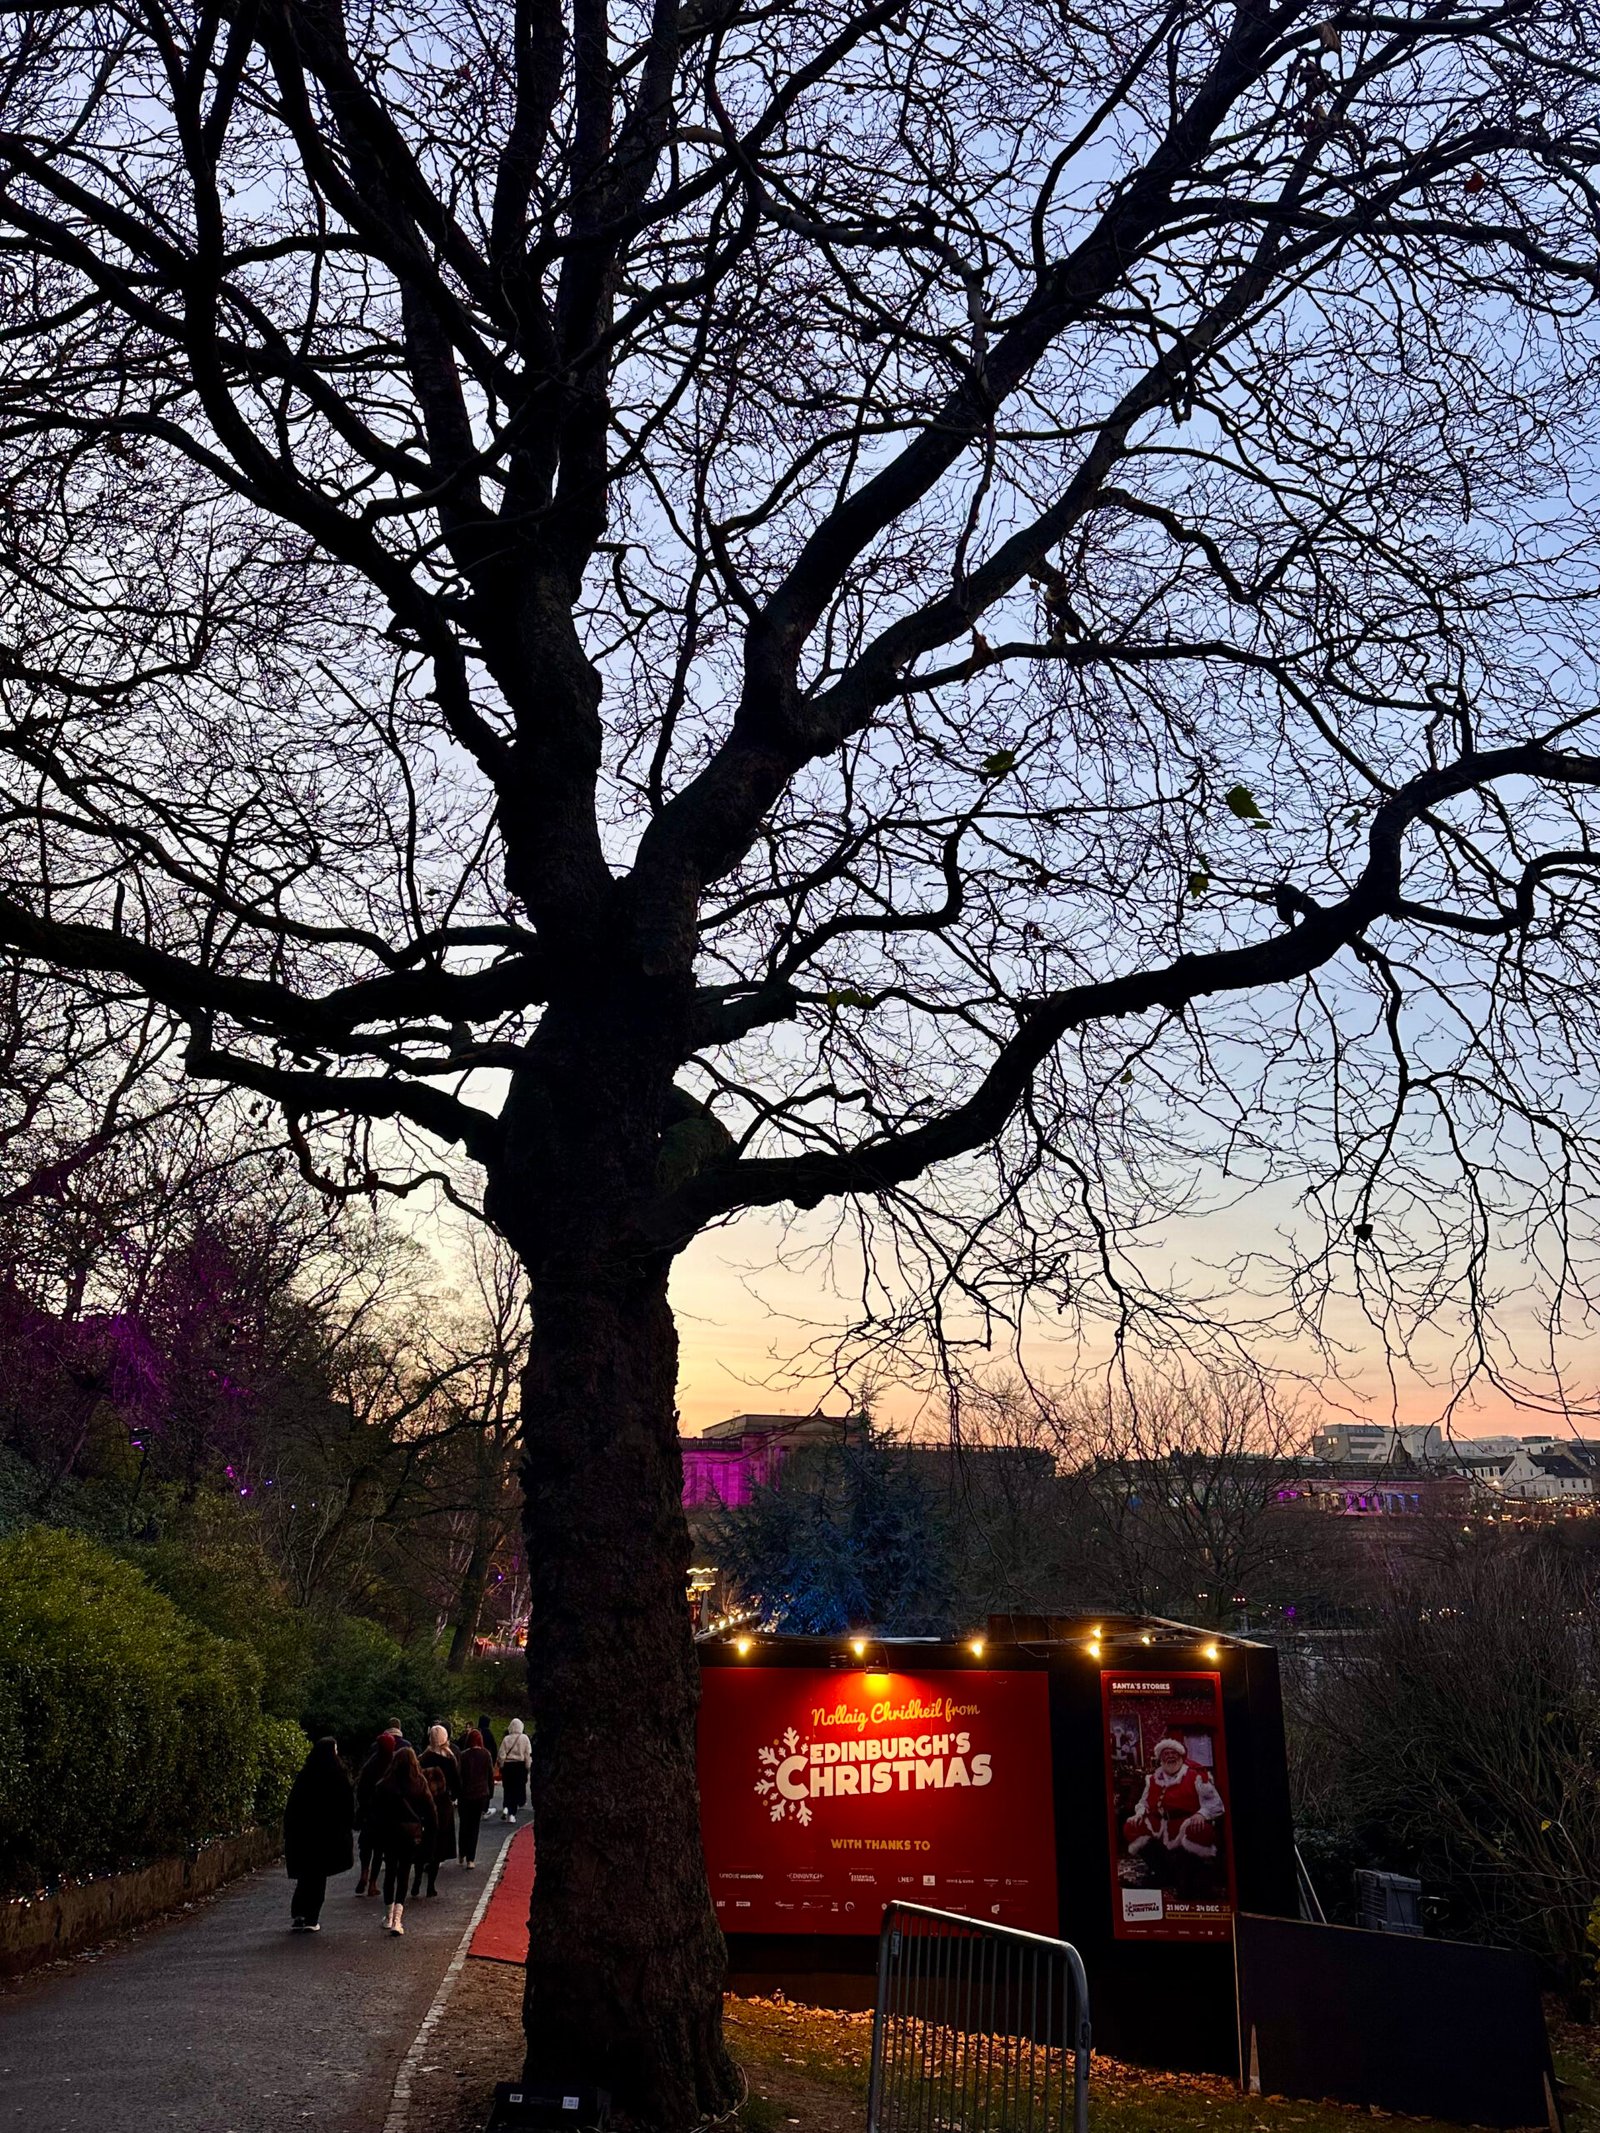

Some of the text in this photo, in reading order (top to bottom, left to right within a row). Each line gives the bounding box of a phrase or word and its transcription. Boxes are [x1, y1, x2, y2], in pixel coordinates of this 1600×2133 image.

[1112, 1682, 1141, 1690] SANTA'S
[811, 1697, 980, 1732] Nollaig Chridheil from
[809, 1731, 971, 1765] EDINBURGH'S
[775, 1753, 993, 1800] CHRISTMAS
[830, 1838, 931, 1851] WITH THANKS TO
[1196, 1904, 1205, 1912] 24
